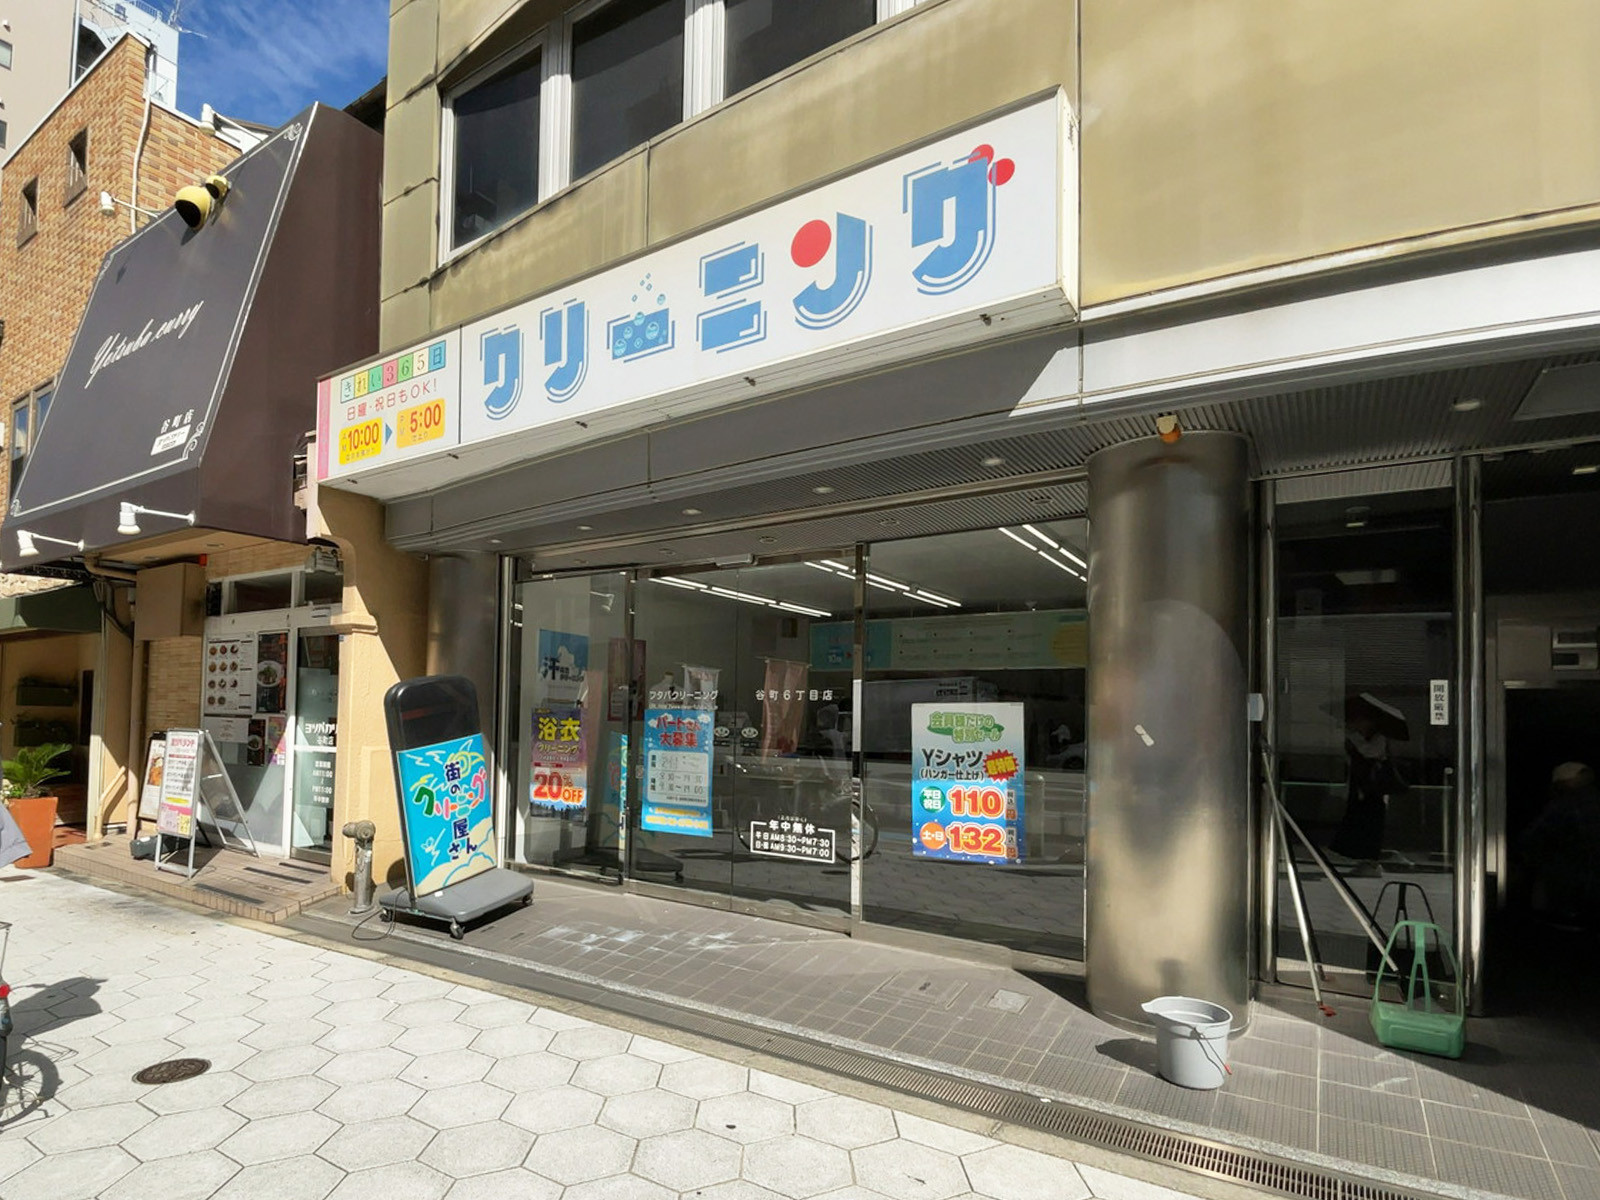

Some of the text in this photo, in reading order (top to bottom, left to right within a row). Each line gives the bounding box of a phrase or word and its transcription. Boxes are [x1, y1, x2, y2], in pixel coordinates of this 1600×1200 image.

[479, 143, 1016, 420] クリーニング
[344, 346, 443, 399] きれい365日
[410, 403, 441, 433] 5:00
[347, 422, 379, 452] 10:00
[755, 689, 834, 701] 谷町6丁目店
[538, 717, 580, 742] 浴衣
[660, 732, 698, 748] 大募集
[922, 748, 983, 768] Yシャツ
[414, 767, 487, 818] クリーニング
[923, 790, 942, 799] 平日
[950, 788, 1001, 818] 110
[769, 819, 816, 835] 年中無休
[950, 826, 1002, 854] 132
